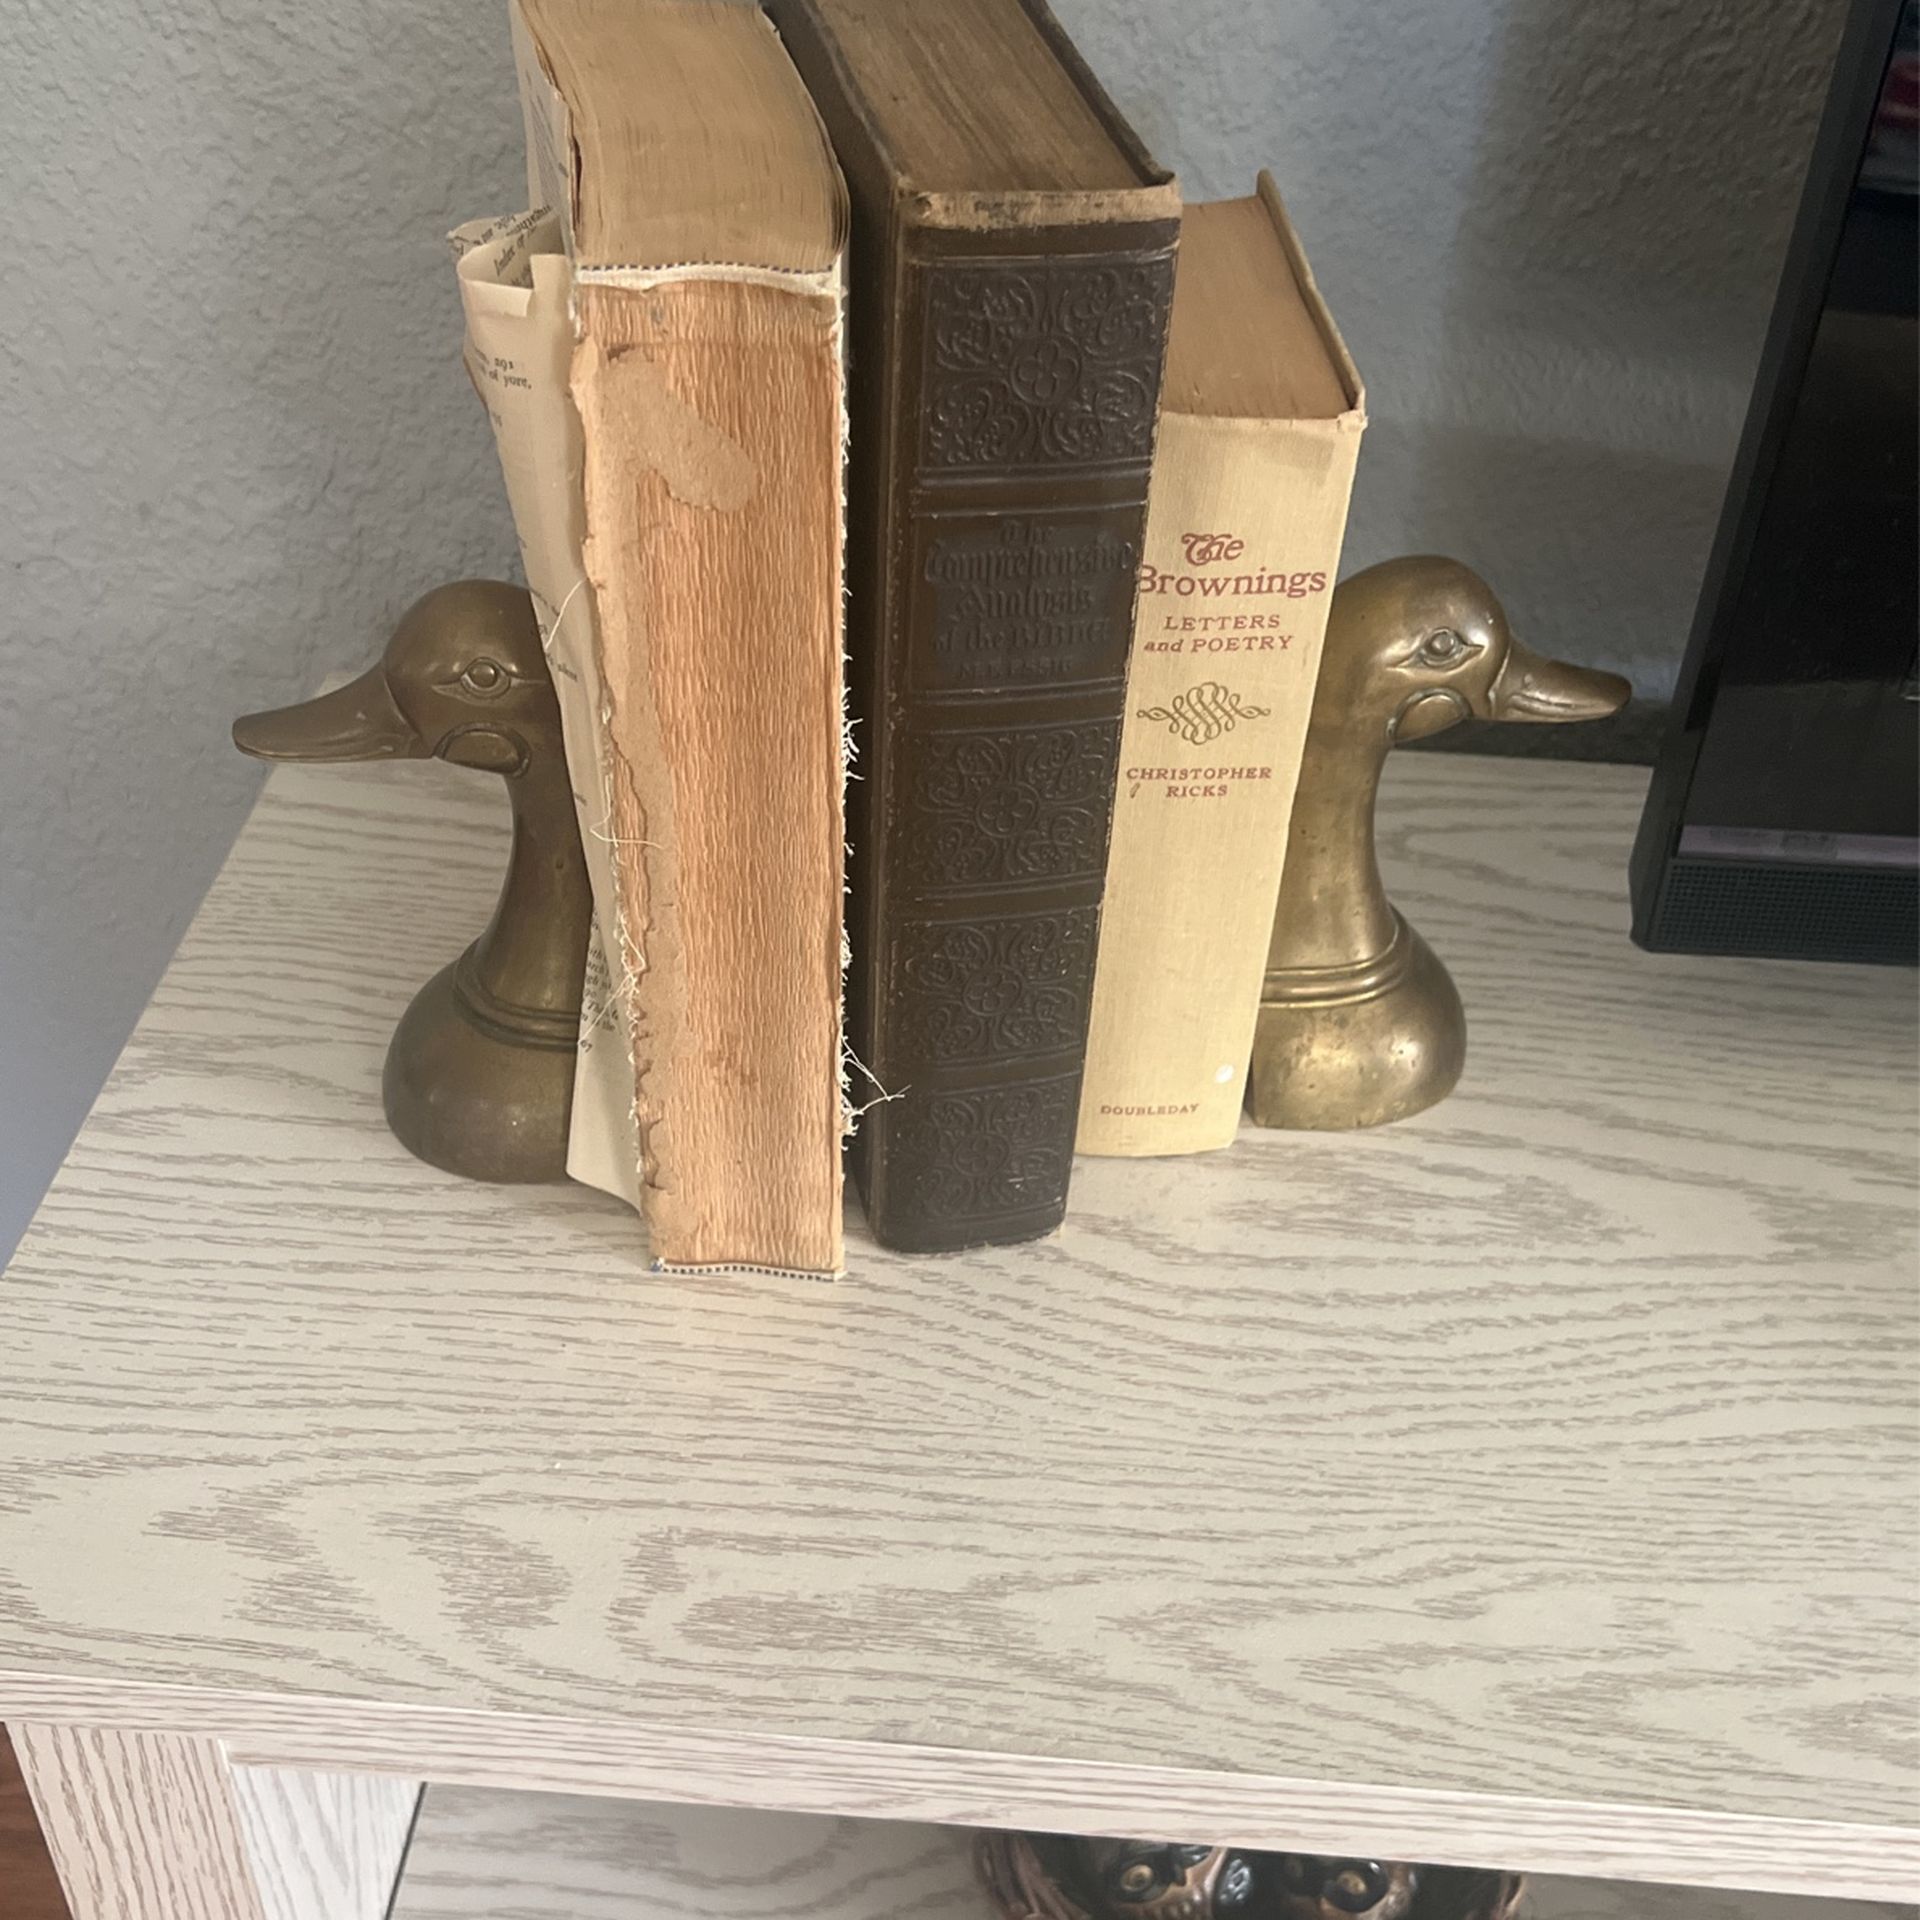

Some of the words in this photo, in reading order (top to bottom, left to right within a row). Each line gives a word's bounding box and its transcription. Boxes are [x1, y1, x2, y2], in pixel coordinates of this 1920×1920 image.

[1181, 532, 1245, 567] The
[1139, 564, 1327, 598] Brownings
[1165, 614, 1281, 632] LETTERS
[1143, 638, 1183, 653] and
[1191, 635, 1294, 653] POETRY
[1126, 766, 1272, 781] CHRISTOPHER
[1166, 784, 1228, 799] RICKS
[1100, 1103, 1200, 1116] DOUBLEDAY
